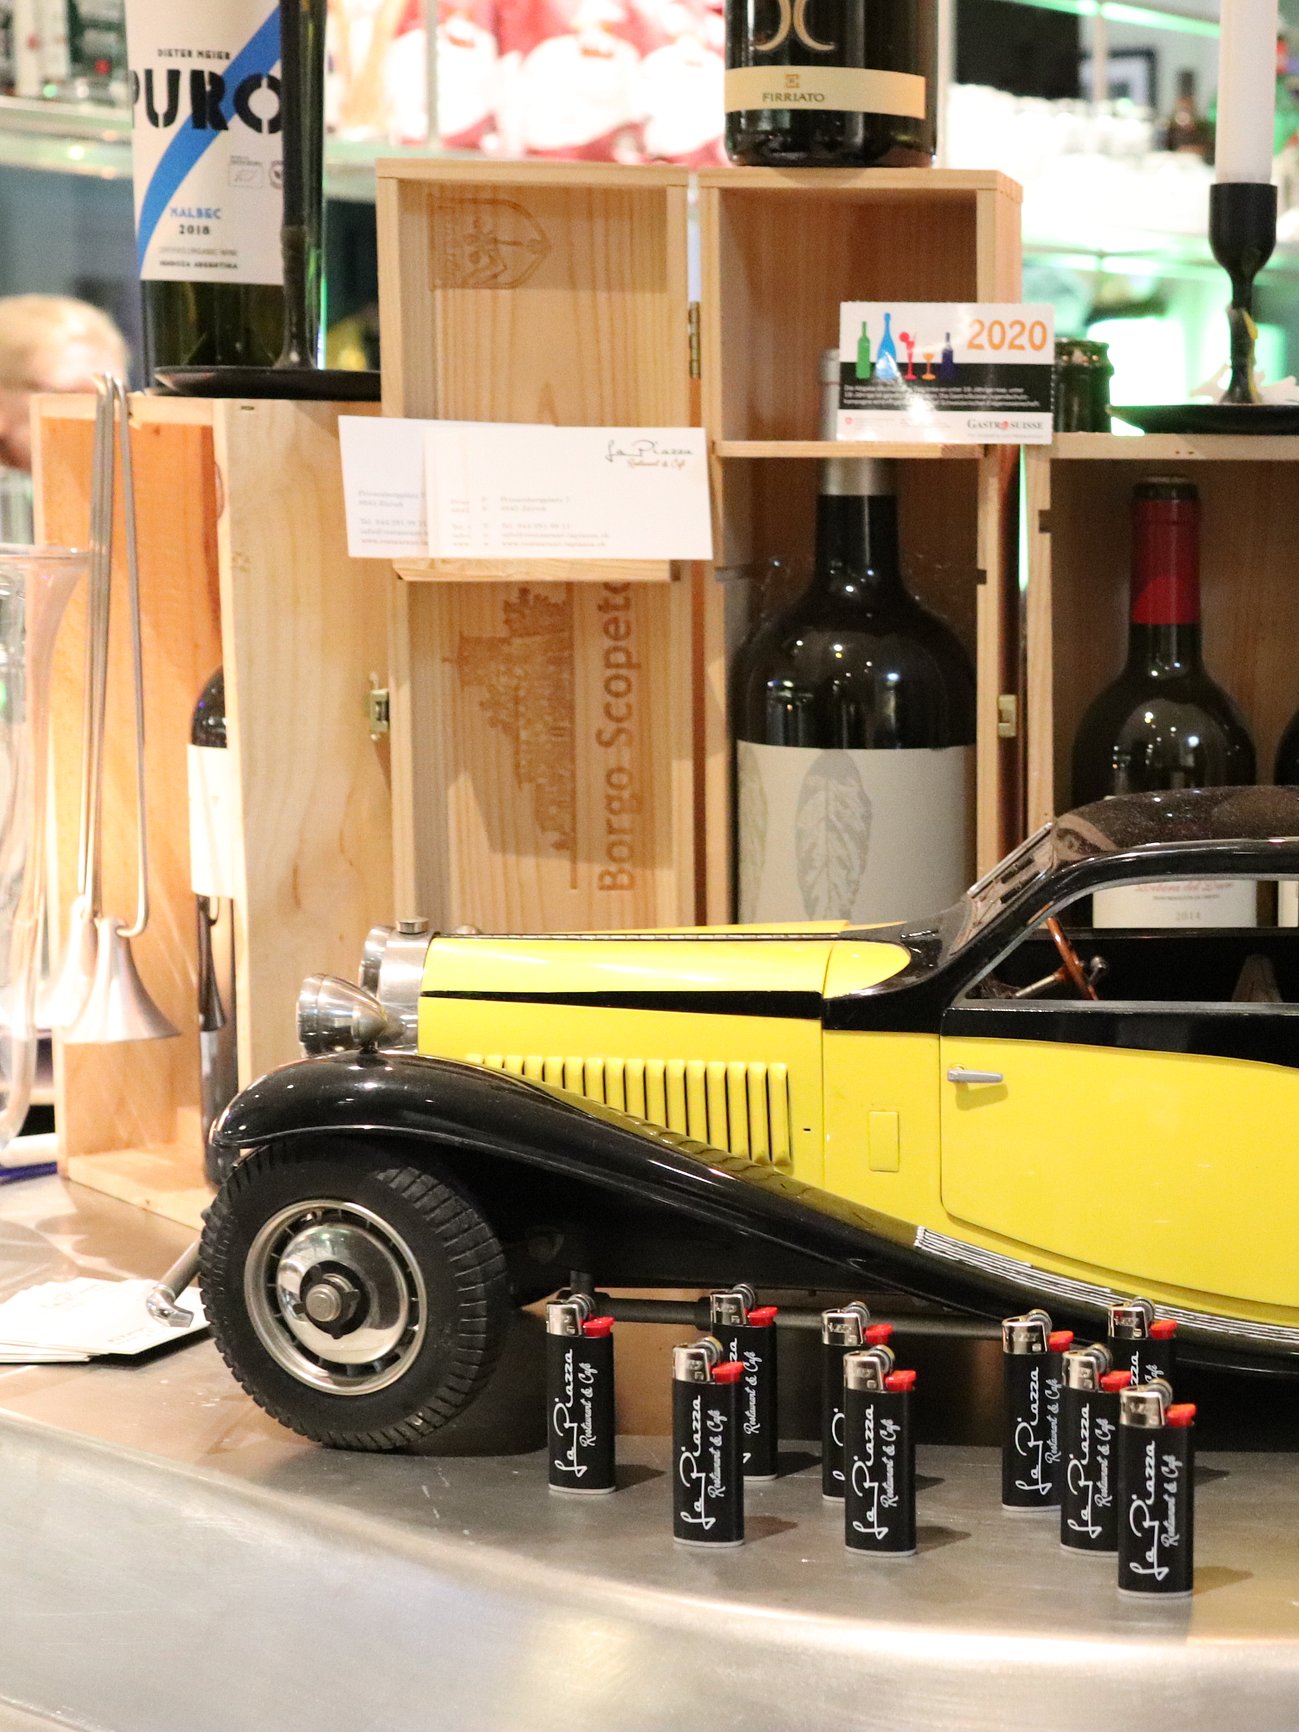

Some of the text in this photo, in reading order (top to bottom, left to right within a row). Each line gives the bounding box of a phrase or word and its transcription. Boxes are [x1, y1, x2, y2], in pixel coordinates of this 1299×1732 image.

[761, 92, 826, 103] FIRRIATO
[169, 206, 222, 220] MALBEC
[966, 318, 1048, 351] 2020
[598, 766, 643, 892] Borgo
[553, 1348, 578, 1437] Piazza
[580, 1386, 594, 1398] &
[1014, 1366, 1044, 1457] Piazza
[579, 1398, 597, 1447] Restaurant
[679, 1394, 706, 1488] Piazza
[708, 1434, 723, 1447] &
[1044, 1414, 1062, 1464] Restaurant
[707, 1447, 727, 1498] Restaurant
[852, 1403, 879, 1497] Piazza
[1066, 1402, 1094, 1496] Piazza
[1128, 1440, 1160, 1538] Piazza
